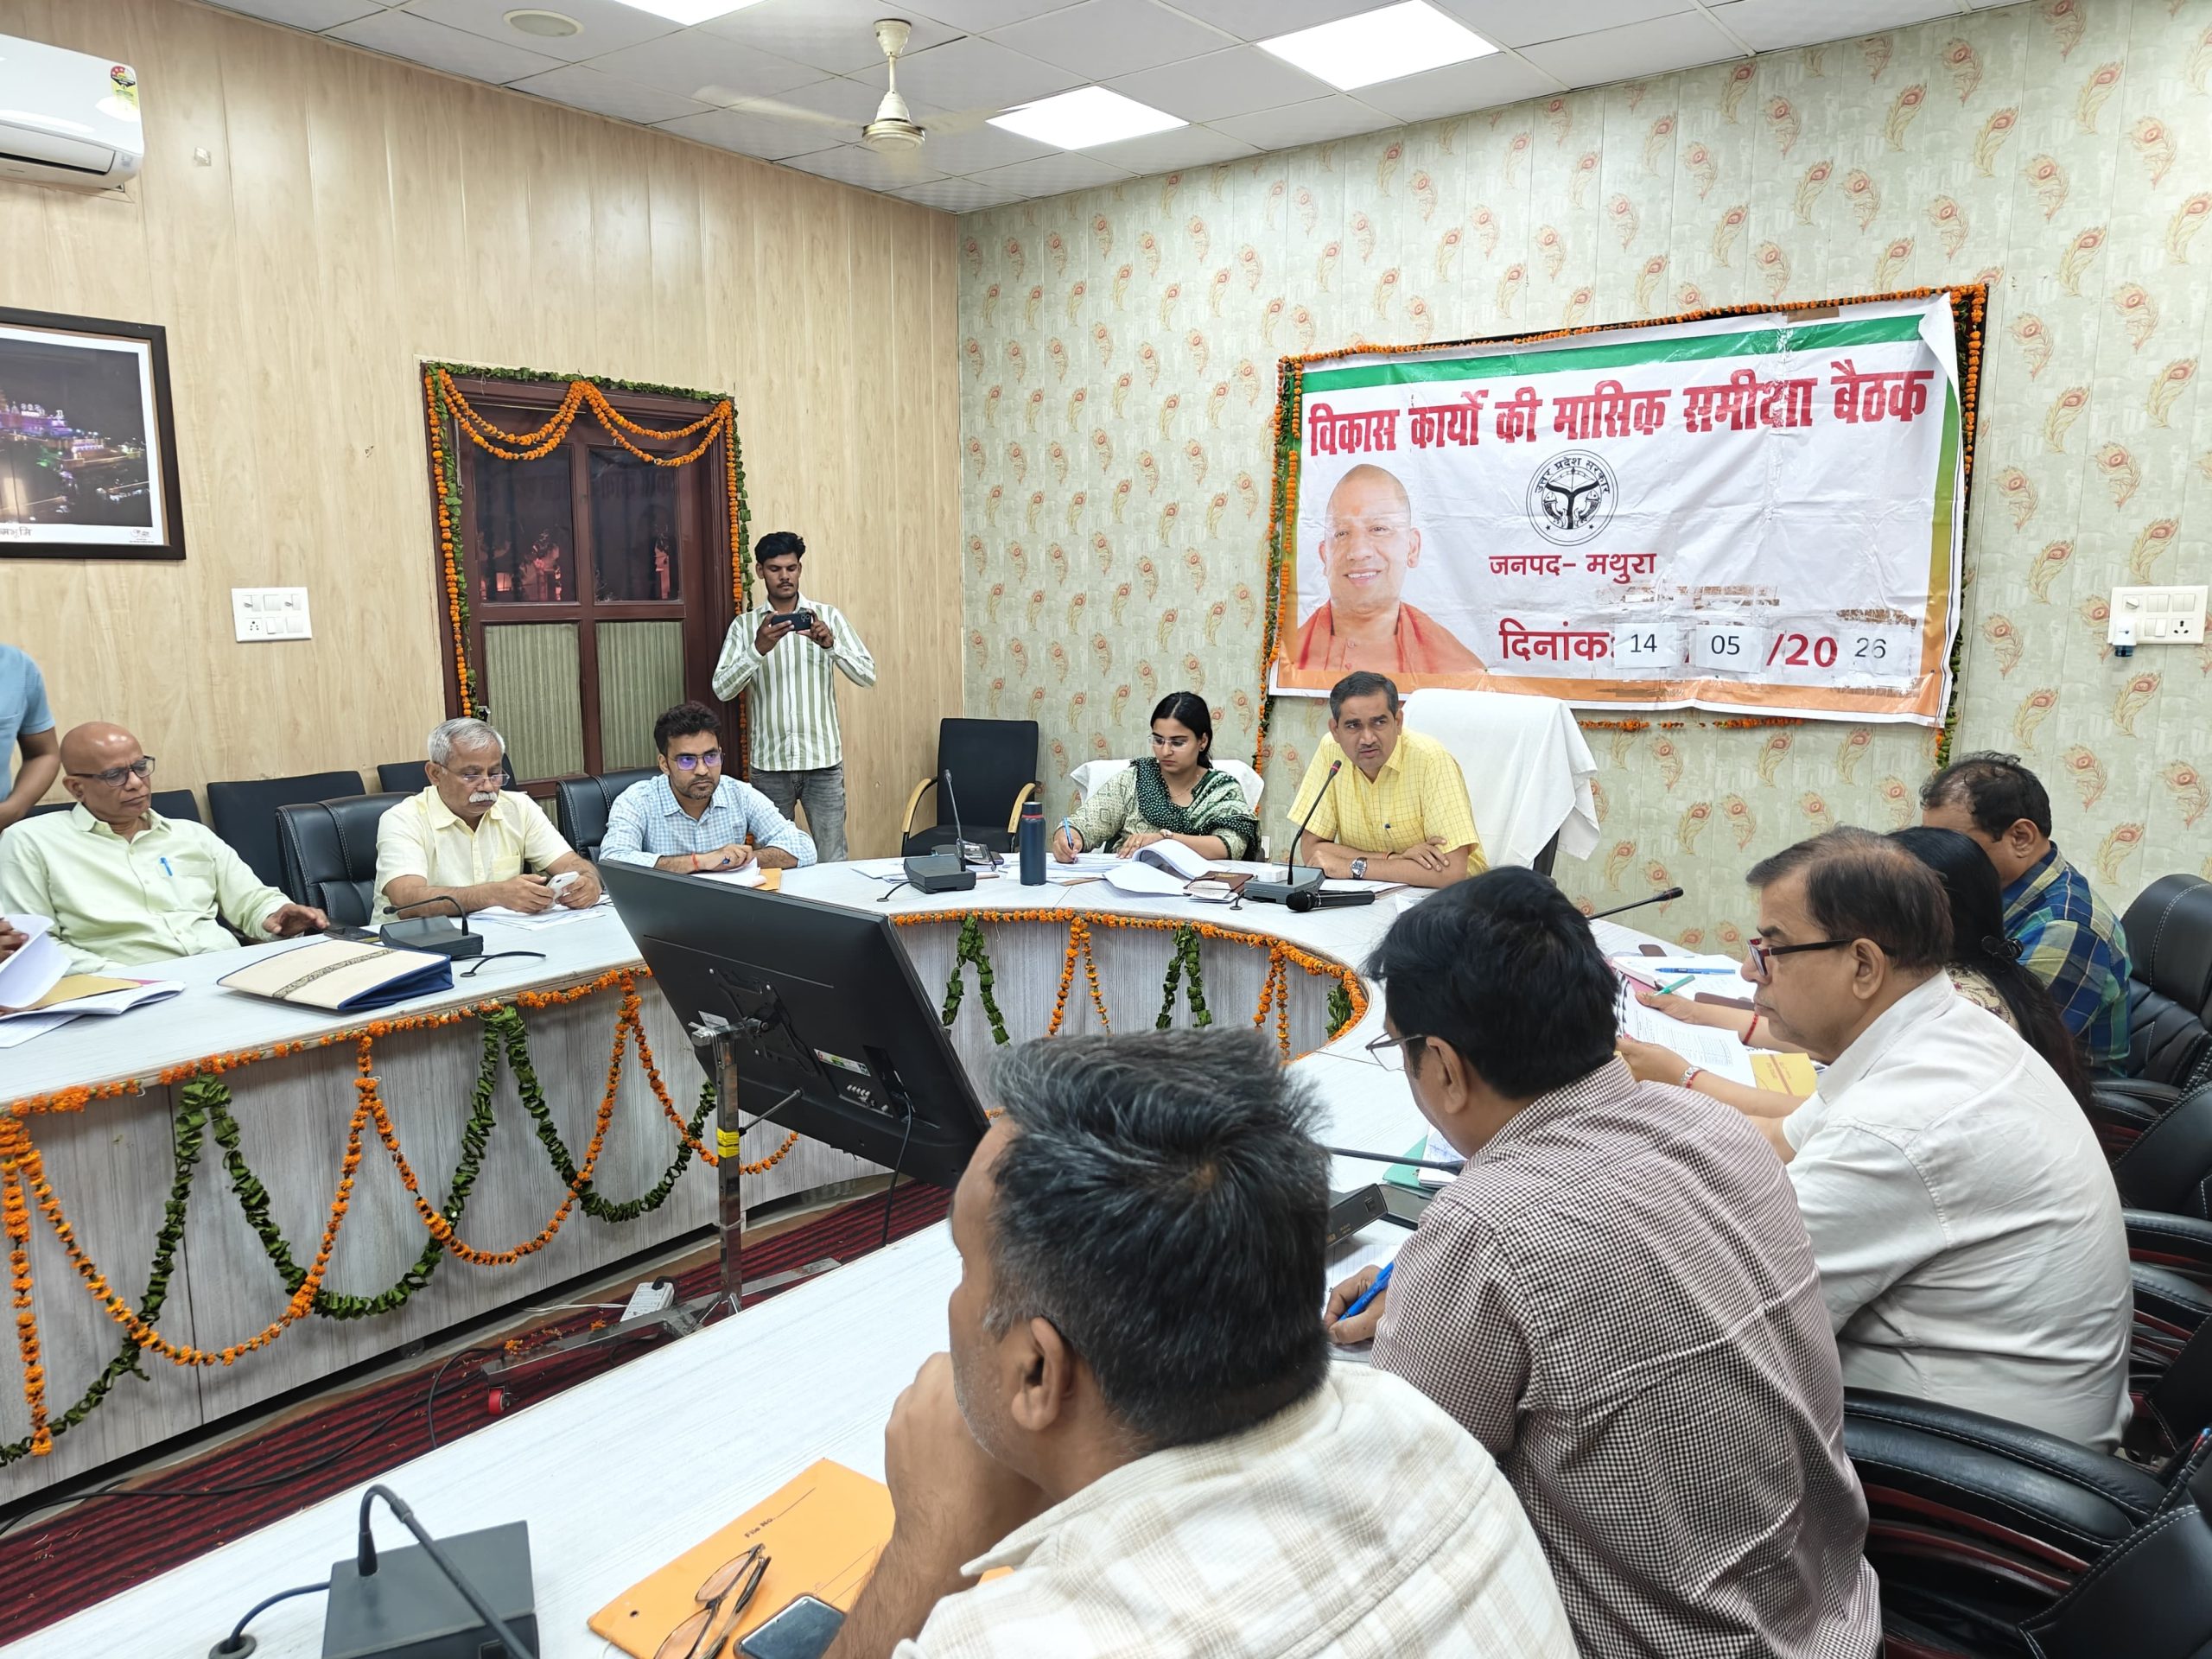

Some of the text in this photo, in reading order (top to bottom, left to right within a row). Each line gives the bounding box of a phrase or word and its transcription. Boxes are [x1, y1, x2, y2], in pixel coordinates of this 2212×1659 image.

[1309, 403, 1400, 456] विकास
[1494, 386, 1542, 443] की
[1553, 380, 1672, 440] मासिक
[1682, 369, 1818, 433] समीक्षा
[1830, 359, 1935, 424] बैठक
[1554, 457, 1582, 470] प्रदेश
[1586, 460, 1611, 494] सरकार
[1586, 553, 1657, 584] मथुरा
[1630, 633, 1657, 653] 14
[1711, 635, 1740, 656] 05
